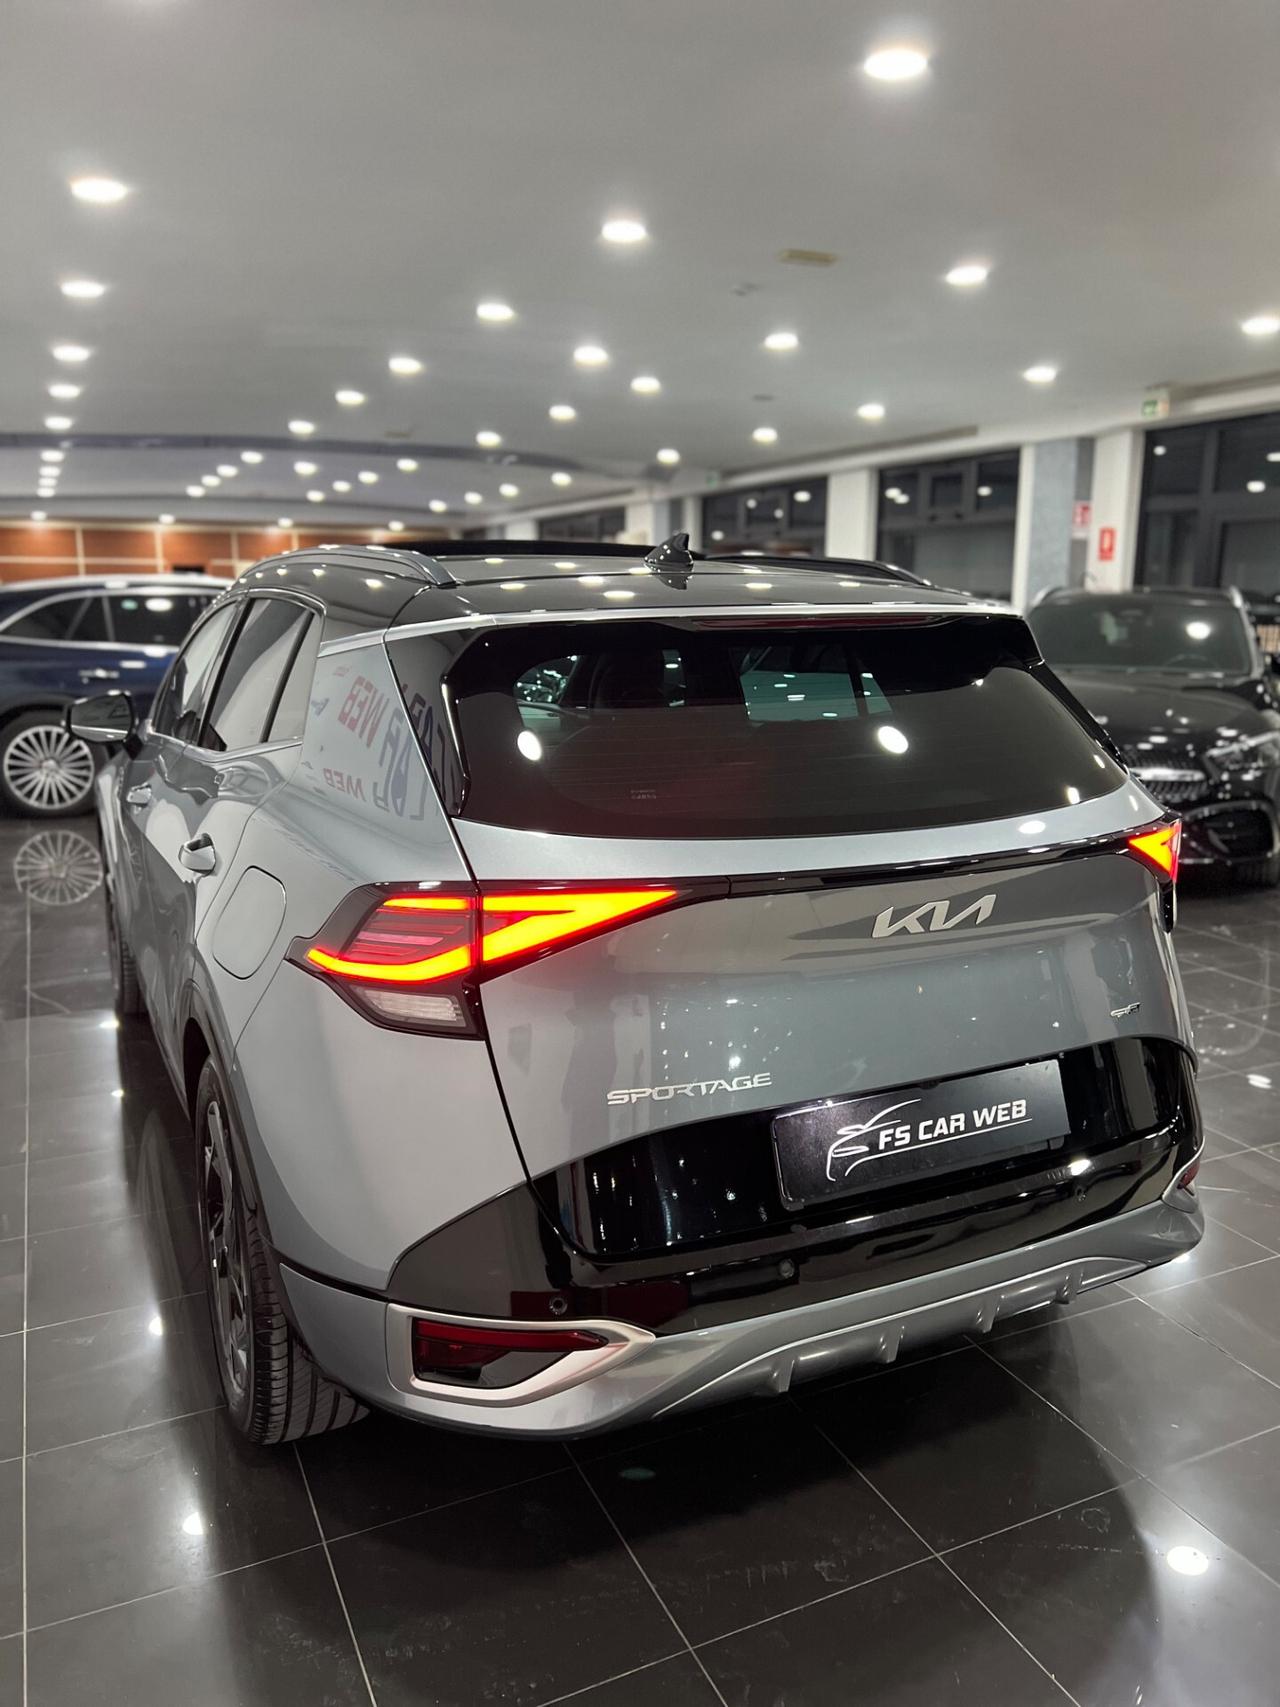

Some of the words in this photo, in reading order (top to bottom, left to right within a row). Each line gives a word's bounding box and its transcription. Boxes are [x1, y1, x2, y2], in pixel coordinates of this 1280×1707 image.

[871, 894, 997, 938] KIA
[606, 1072, 773, 1105] SPORTAGE
[878, 1127, 912, 1151] FS
[918, 1114, 966, 1141] CAR
[974, 1099, 1028, 1129] WEB
